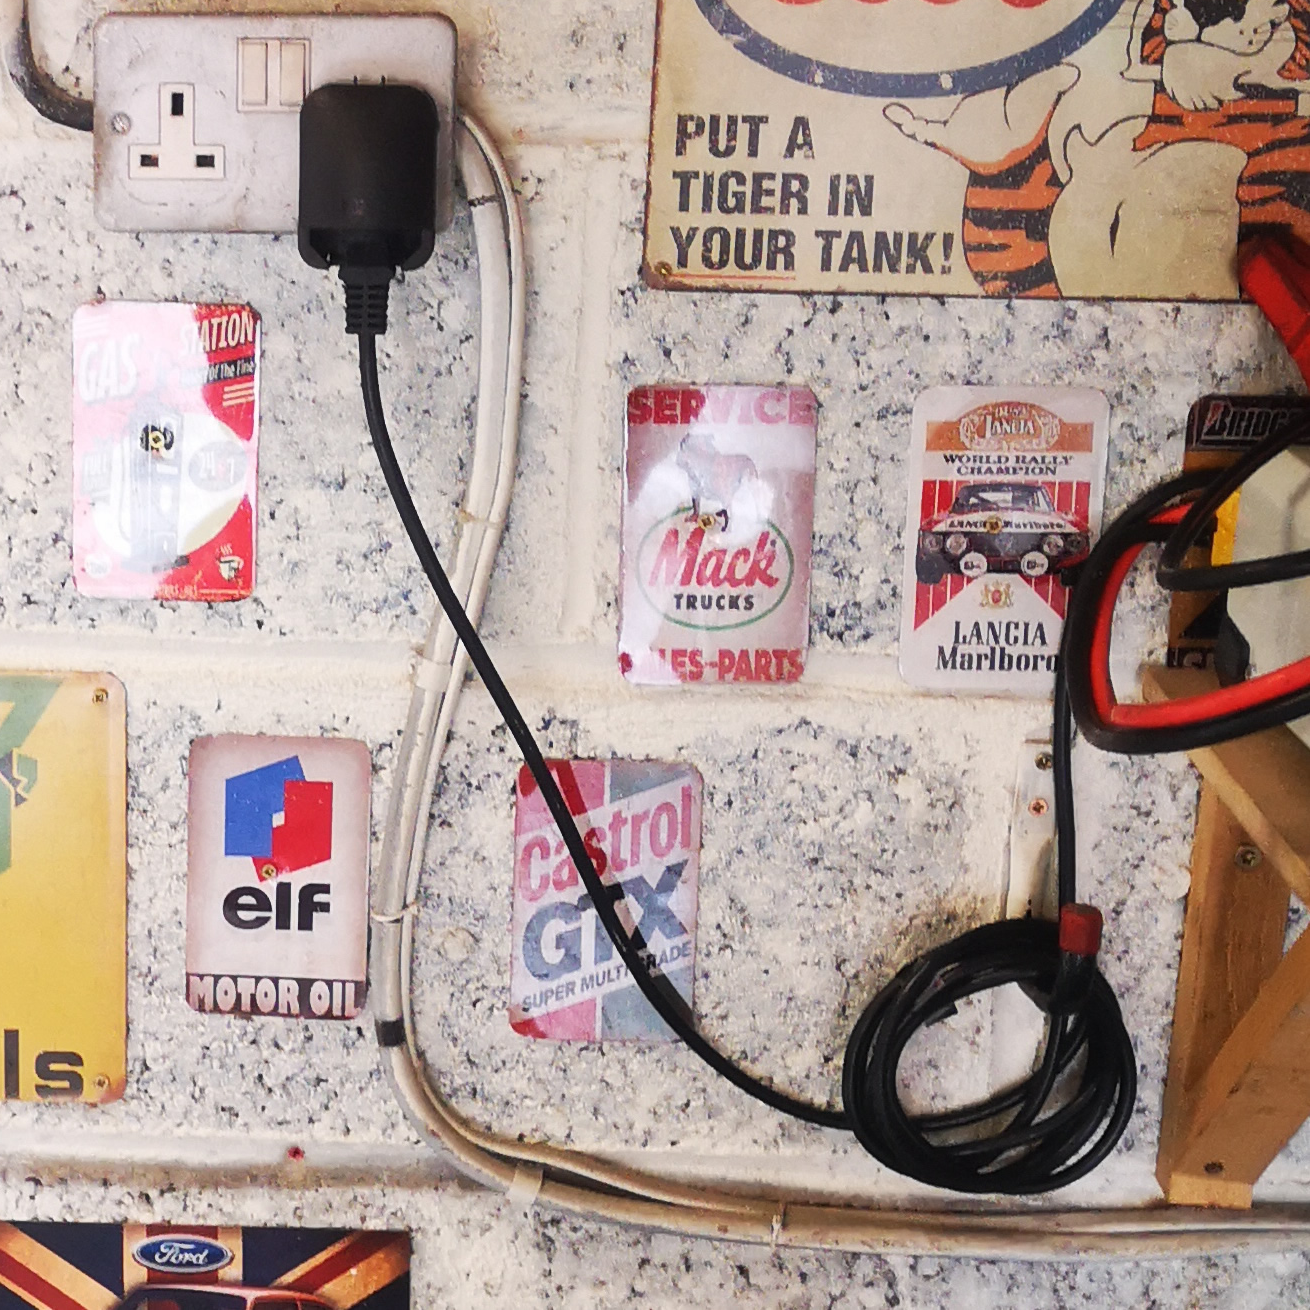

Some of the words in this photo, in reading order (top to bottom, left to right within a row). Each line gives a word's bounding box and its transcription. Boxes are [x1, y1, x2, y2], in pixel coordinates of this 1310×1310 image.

[674, 113, 769, 159] PUT
[782, 115, 816, 160] A
[671, 170, 810, 217] TIGER
[827, 173, 875, 217] IN
[669, 226, 796, 272] YOUR
[814, 229, 955, 276] TANK!
[628, 389, 815, 425] SERVICE
[942, 453, 1010, 465] WORLD
[1014, 453, 1074, 466] RALLY
[955, 465, 1057, 477] CHAMPION
[648, 526, 780, 589] Mack
[673, 592, 756, 611] TRUCKS
[953, 620, 1048, 647] LANCIA
[935, 645, 1059, 672] Marlboro
[519, 785, 692, 903] Castrol
[222, 881, 331, 931] elf
[190, 975, 300, 1016] MOTOR
[309, 980, 361, 1019] OIL
[522, 979, 577, 1012] SUPER
[579, 940, 692, 992] MULTIRADE
[154, 1242, 209, 1266] Ford
